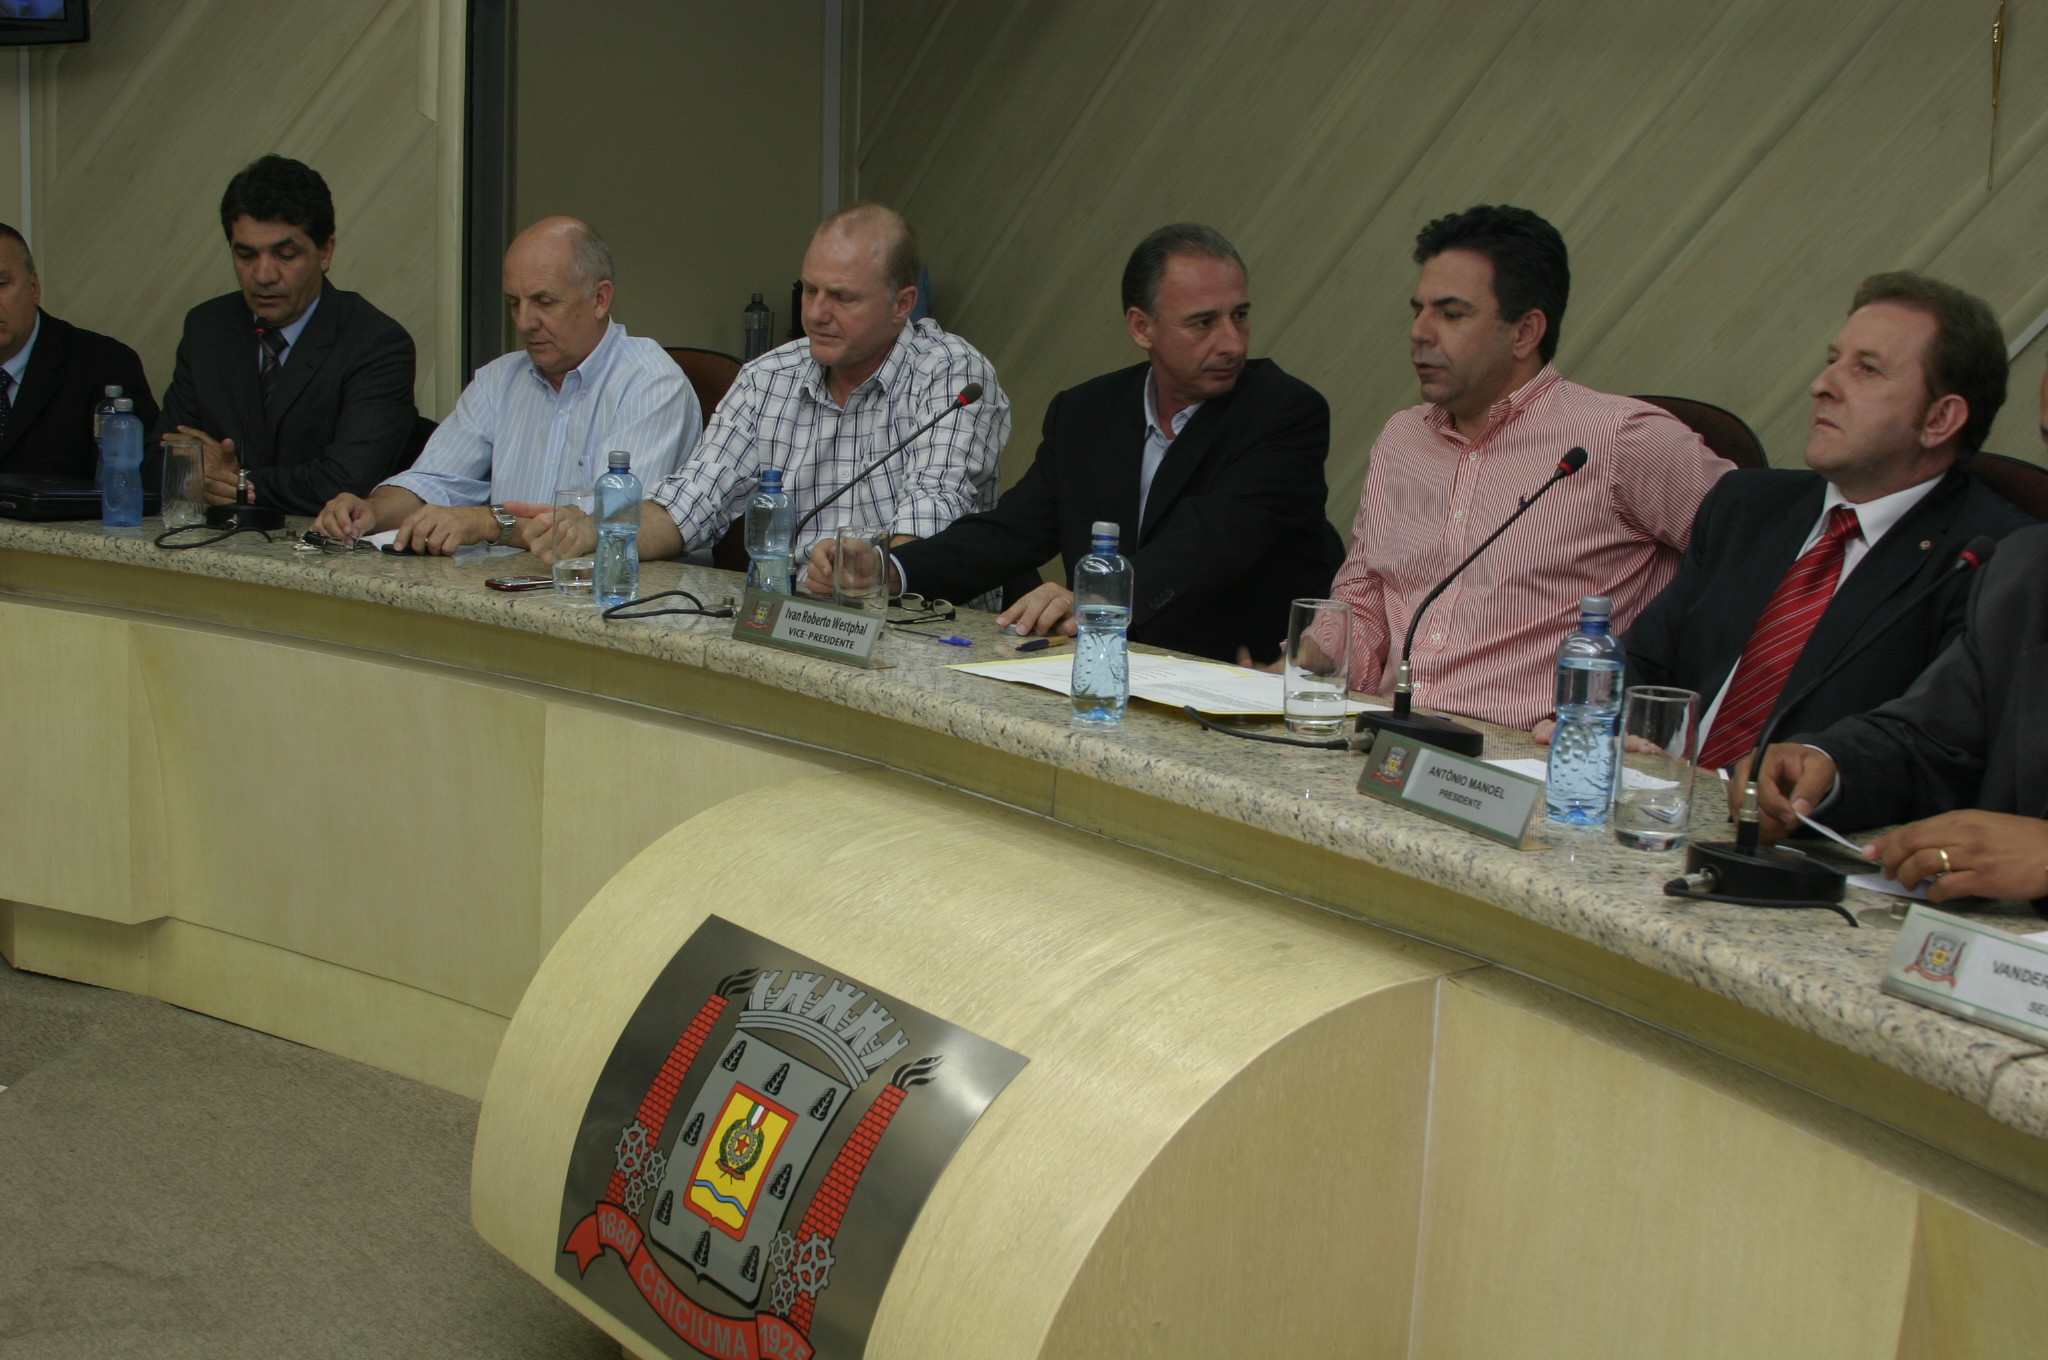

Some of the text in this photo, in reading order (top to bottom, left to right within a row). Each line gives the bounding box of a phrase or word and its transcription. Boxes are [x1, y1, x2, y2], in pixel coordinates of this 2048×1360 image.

[785, 607, 868, 636] Ivan Roberto Westphal
[788, 627, 855, 649] VICE-PRESIDENTE
[1428, 766, 1506, 799] ANTÔNIO MANOEL
[1438, 788, 1483, 810] PRESIDENTE
[599, 1212, 637, 1256] 1880
